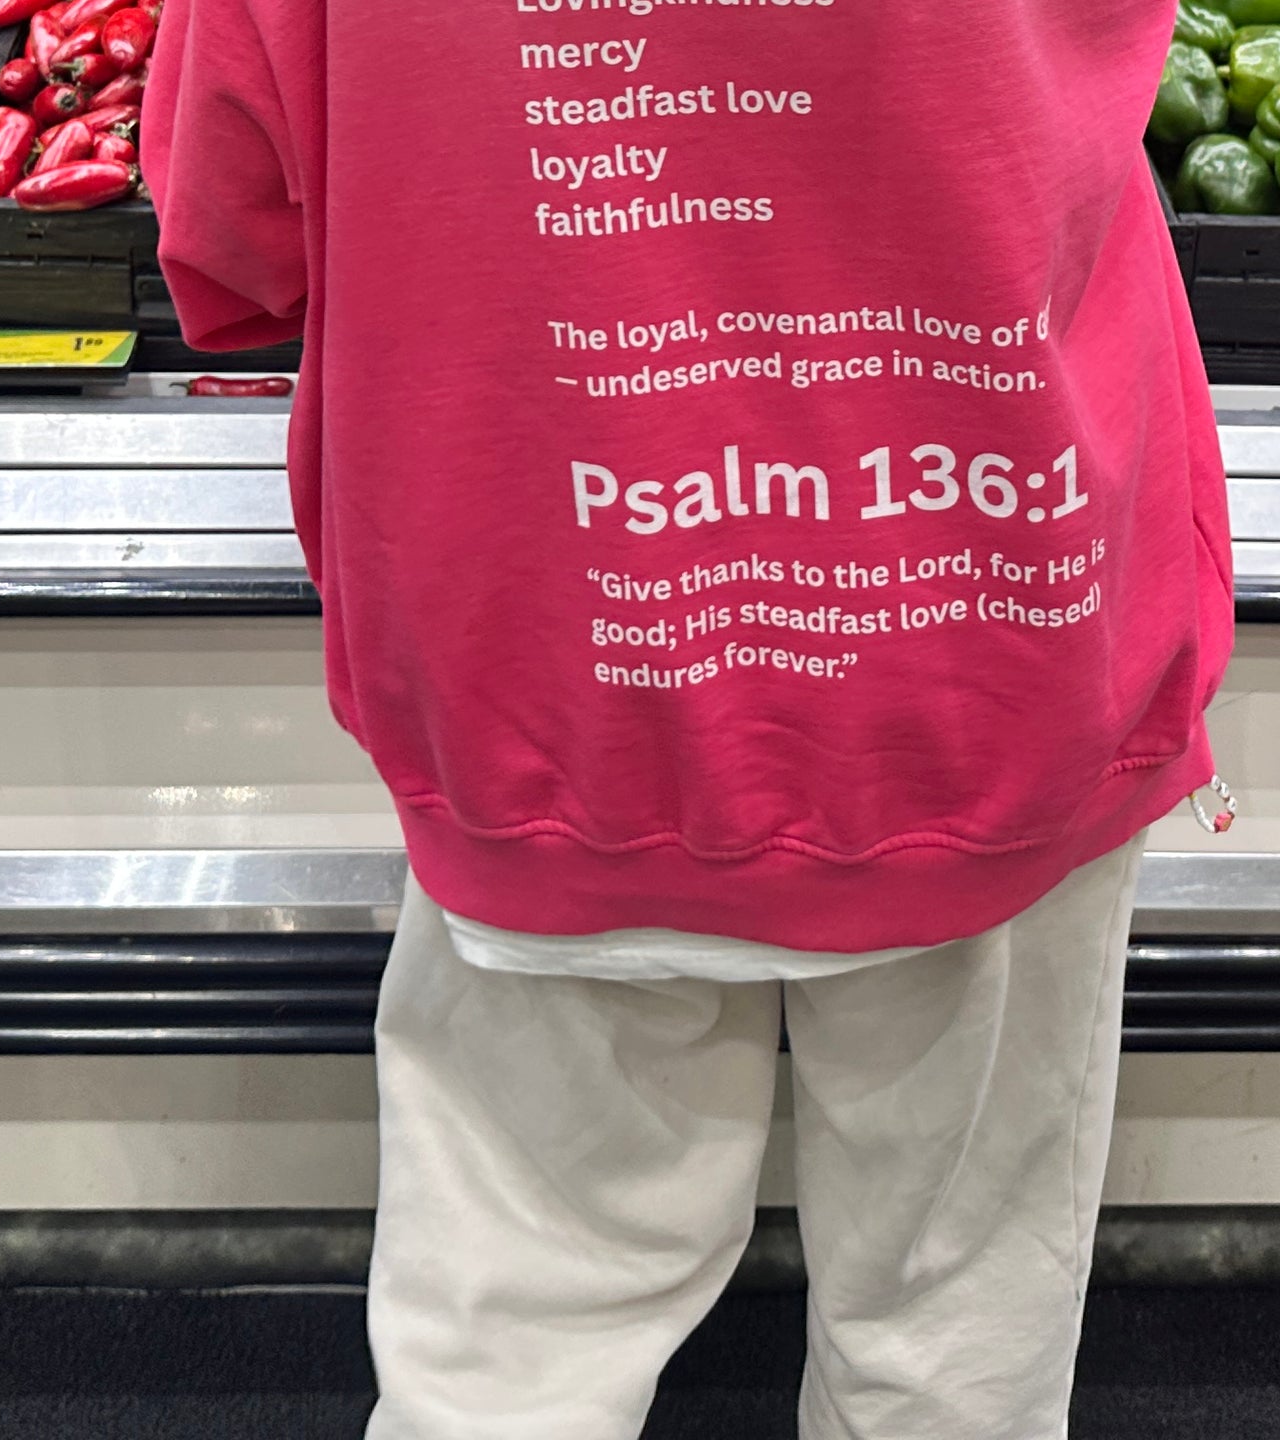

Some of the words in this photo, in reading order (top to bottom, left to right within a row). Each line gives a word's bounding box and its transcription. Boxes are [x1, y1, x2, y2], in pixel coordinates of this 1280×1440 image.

[520, 36, 647, 75] mercy
[524, 83, 717, 127] steadfast
[726, 81, 812, 116] love
[530, 143, 668, 190] loyalty
[534, 192, 774, 238] faithfulness
[547, 320, 608, 351] The
[617, 310, 709, 354] loyal,
[717, 305, 905, 335] covenantal
[913, 308, 981, 345] love
[991, 317, 1030, 347] of
[586, 353, 783, 398] undeserved
[791, 355, 884, 391] grace
[892, 349, 923, 377] in
[932, 360, 1047, 393] action.
[570, 445, 831, 536] Psalm
[858, 443, 1089, 523] 136:1
[586, 567, 672, 602] “Give
[679, 554, 784, 594] thanks
[792, 559, 826, 588] to
[832, 551, 889, 589] the
[897, 548, 982, 583] Lord,
[989, 553, 1035, 584] for
[1047, 553, 1085, 584] He
[1090, 537, 1106, 567] is
[590, 617, 678, 651] good;
[686, 604, 732, 640] His
[740, 598, 891, 636] steadfast
[900, 597, 968, 630] love
[976, 589, 1102, 628] (chesed)
[593, 651, 718, 689] endures
[724, 642, 858, 681] forever.”
